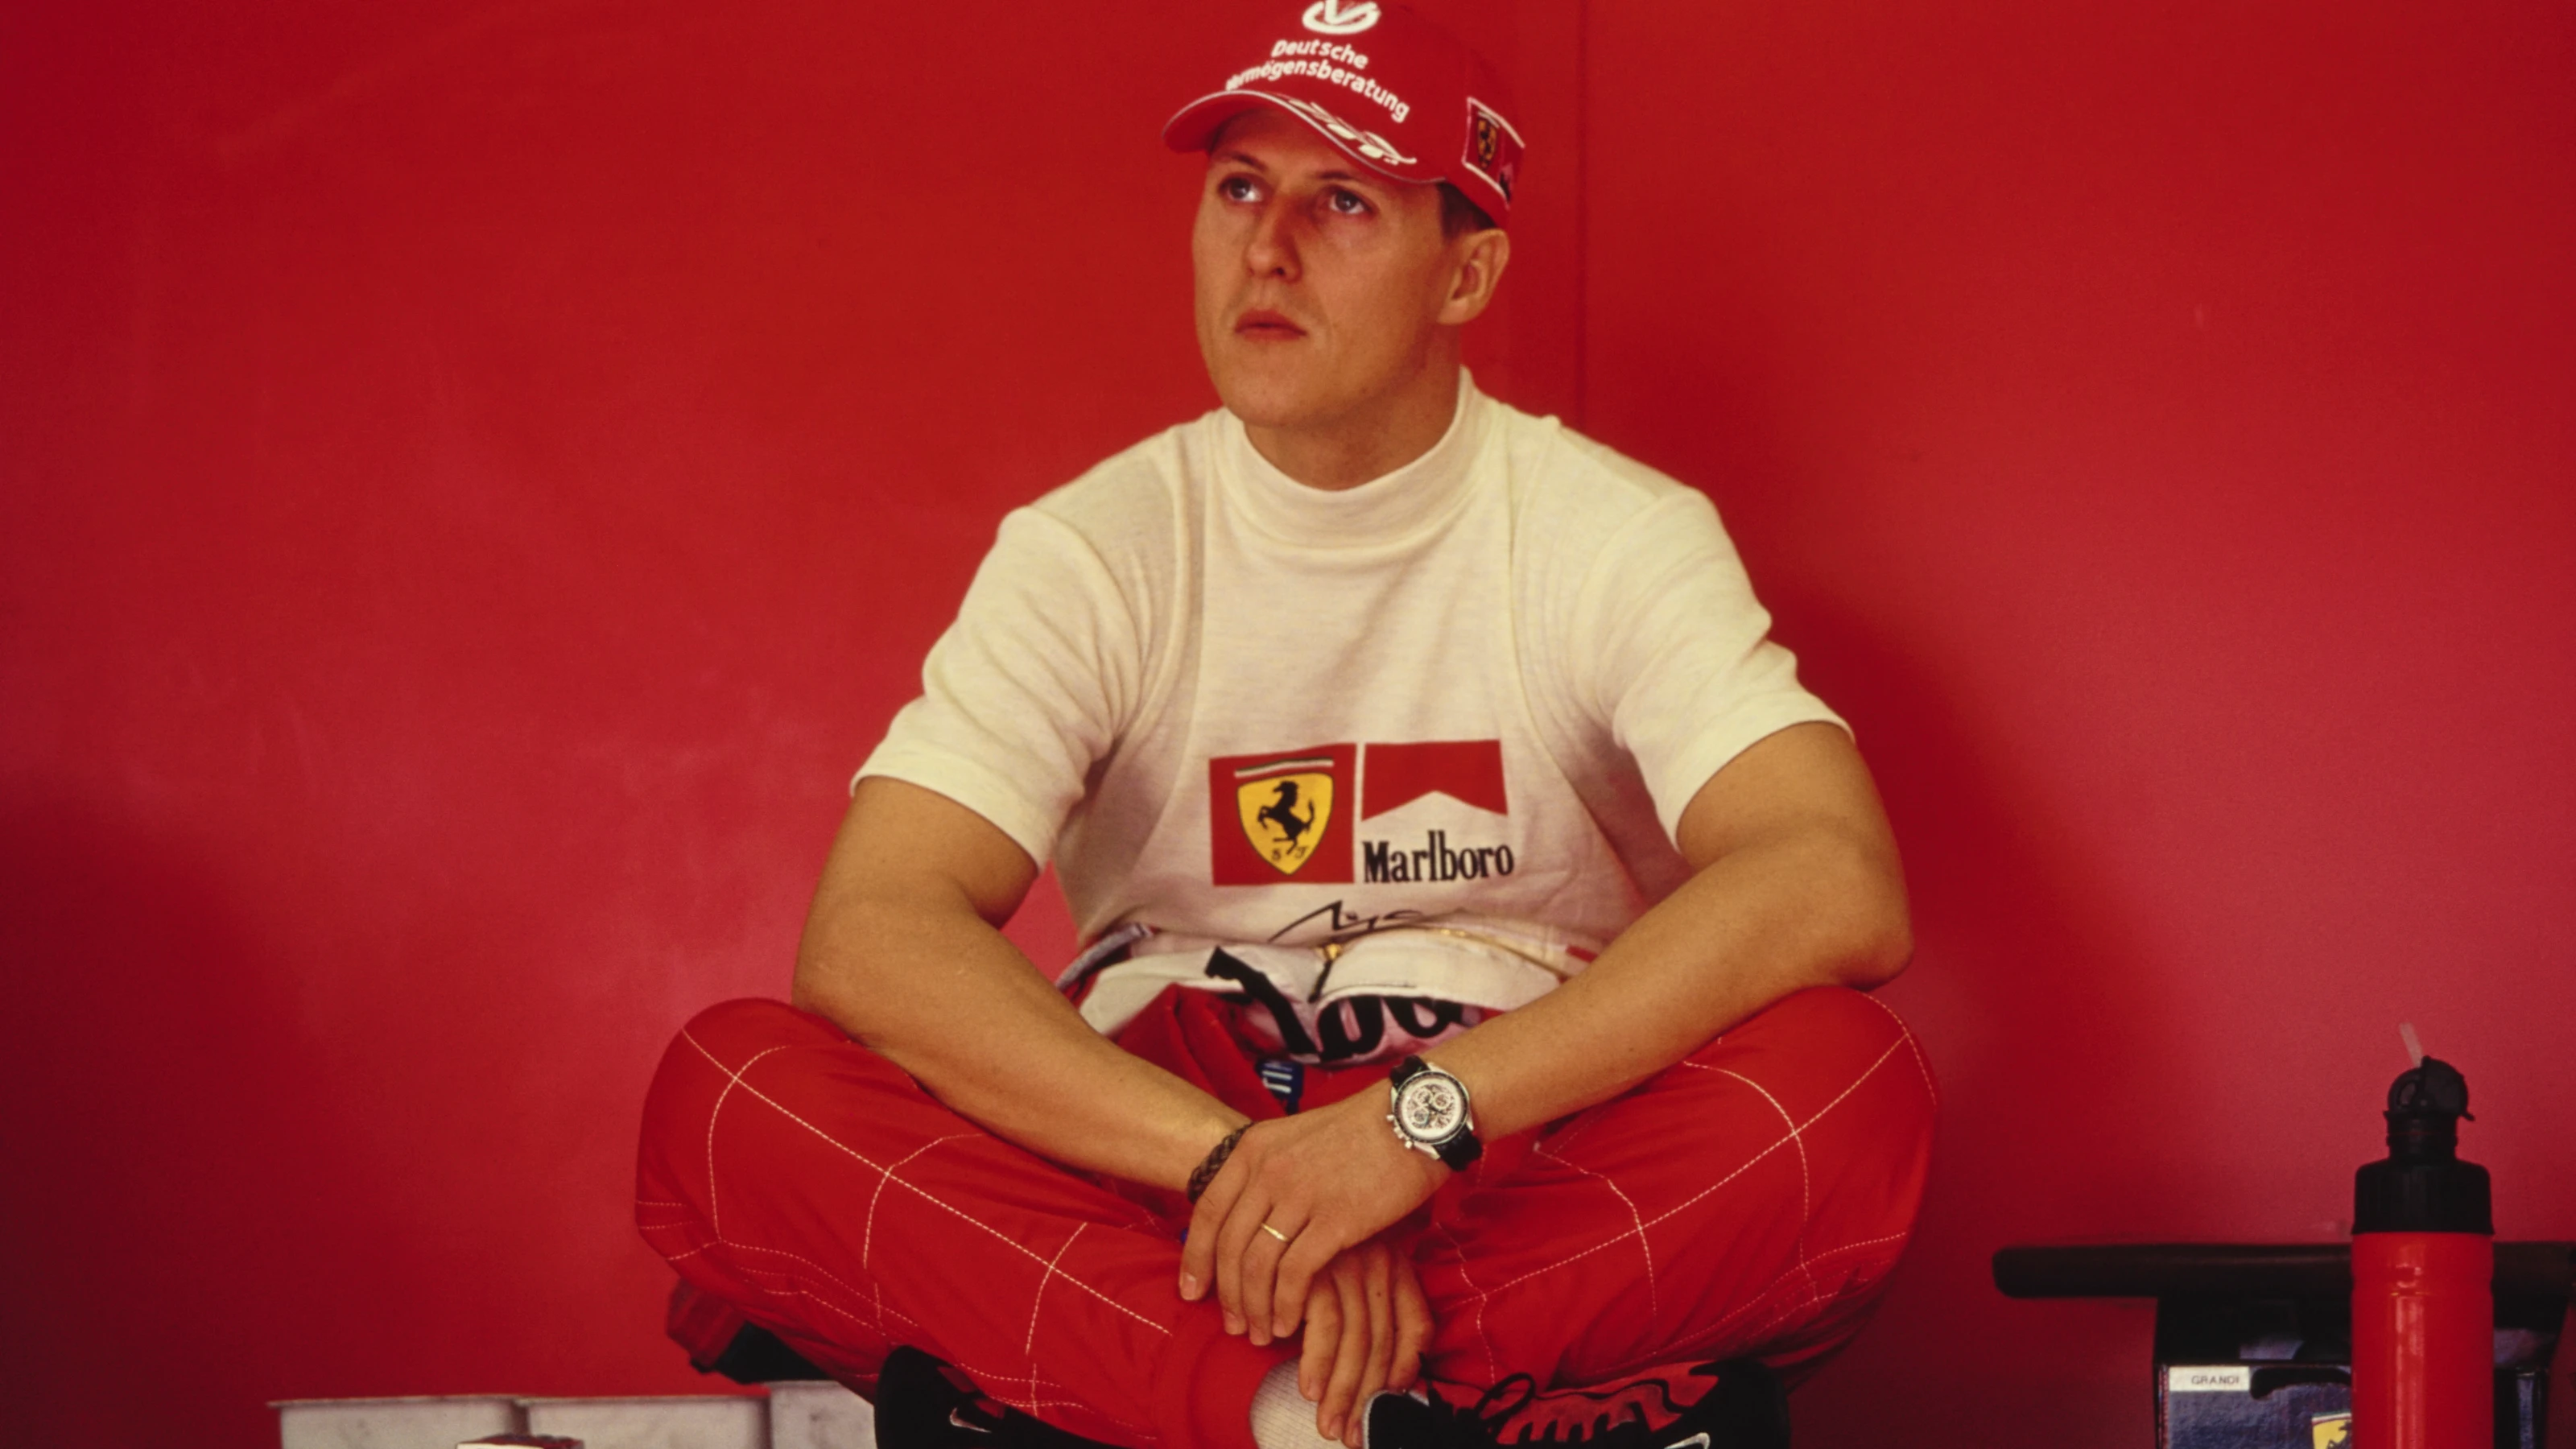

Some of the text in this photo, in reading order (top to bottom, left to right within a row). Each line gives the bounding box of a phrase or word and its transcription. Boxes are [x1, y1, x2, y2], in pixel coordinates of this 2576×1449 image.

[1270, 39, 1368, 69] Deutsche
[1362, 830, 1514, 883] Marlboro
[2191, 1375, 2240, 1385] GRANDI
